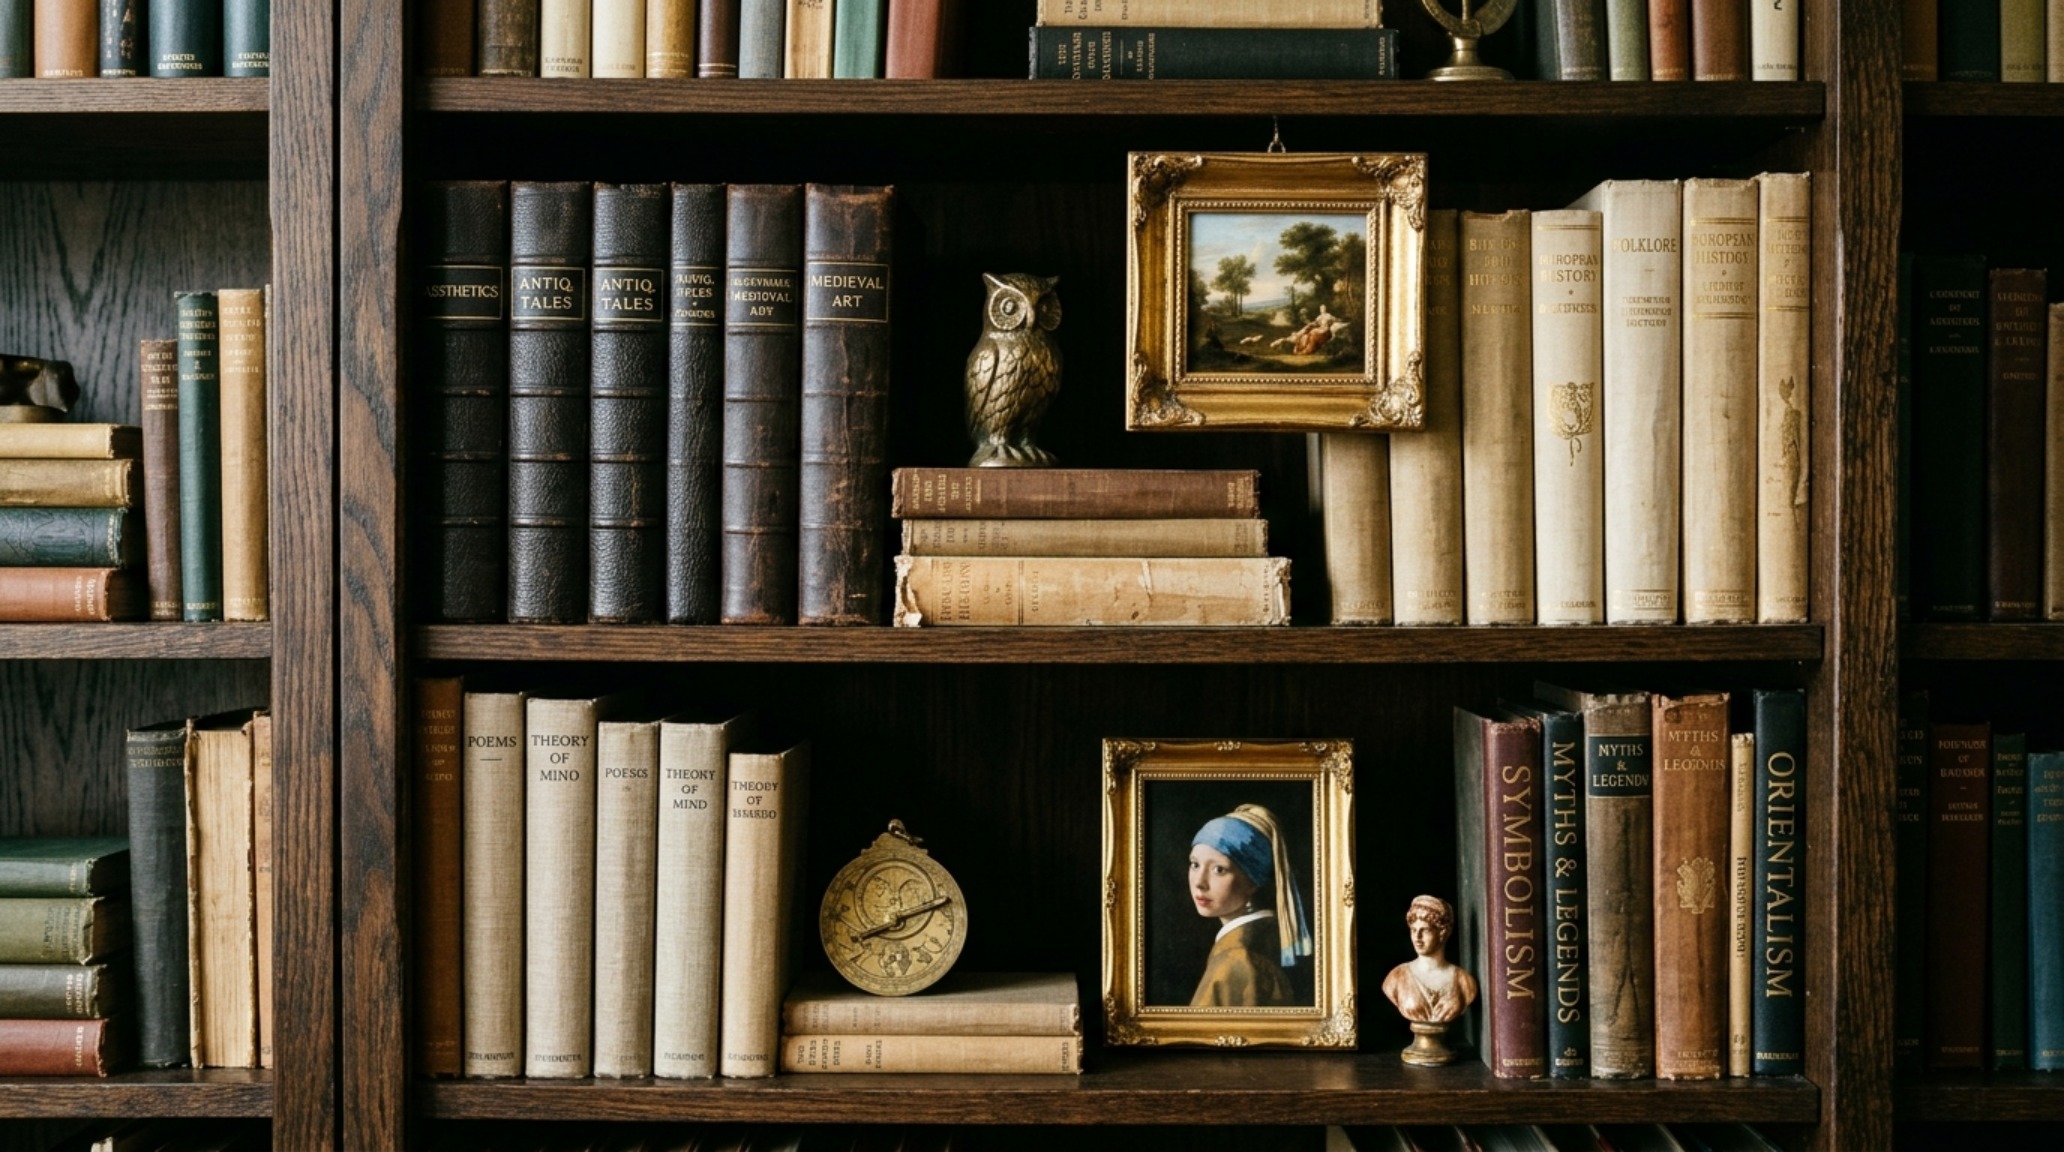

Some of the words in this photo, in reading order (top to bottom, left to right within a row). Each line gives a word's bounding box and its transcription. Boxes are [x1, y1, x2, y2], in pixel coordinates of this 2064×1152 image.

[520, 277, 574, 292] ANTIQ.
[601, 278, 656, 293] ANTIQ.
[811, 275, 884, 289] MEDIEVAL
[520, 296, 573, 309] TALES
[601, 297, 654, 311] TALES
[832, 295, 863, 308] ART
[467, 735, 517, 748] POEMS
[531, 734, 589, 747] THEORY
[549, 752, 570, 764] OF
[681, 784, 698, 794] OF
[1552, 742, 1577, 845] MYTHS
[673, 799, 708, 810] MIND
[746, 796, 762, 806] OF
[1555, 857, 1577, 879] &
[1767, 751, 1796, 999] ORIENTALISM
[1502, 765, 1535, 1001] SYMBOLISM
[1556, 888, 1581, 1024] LEGENDS
